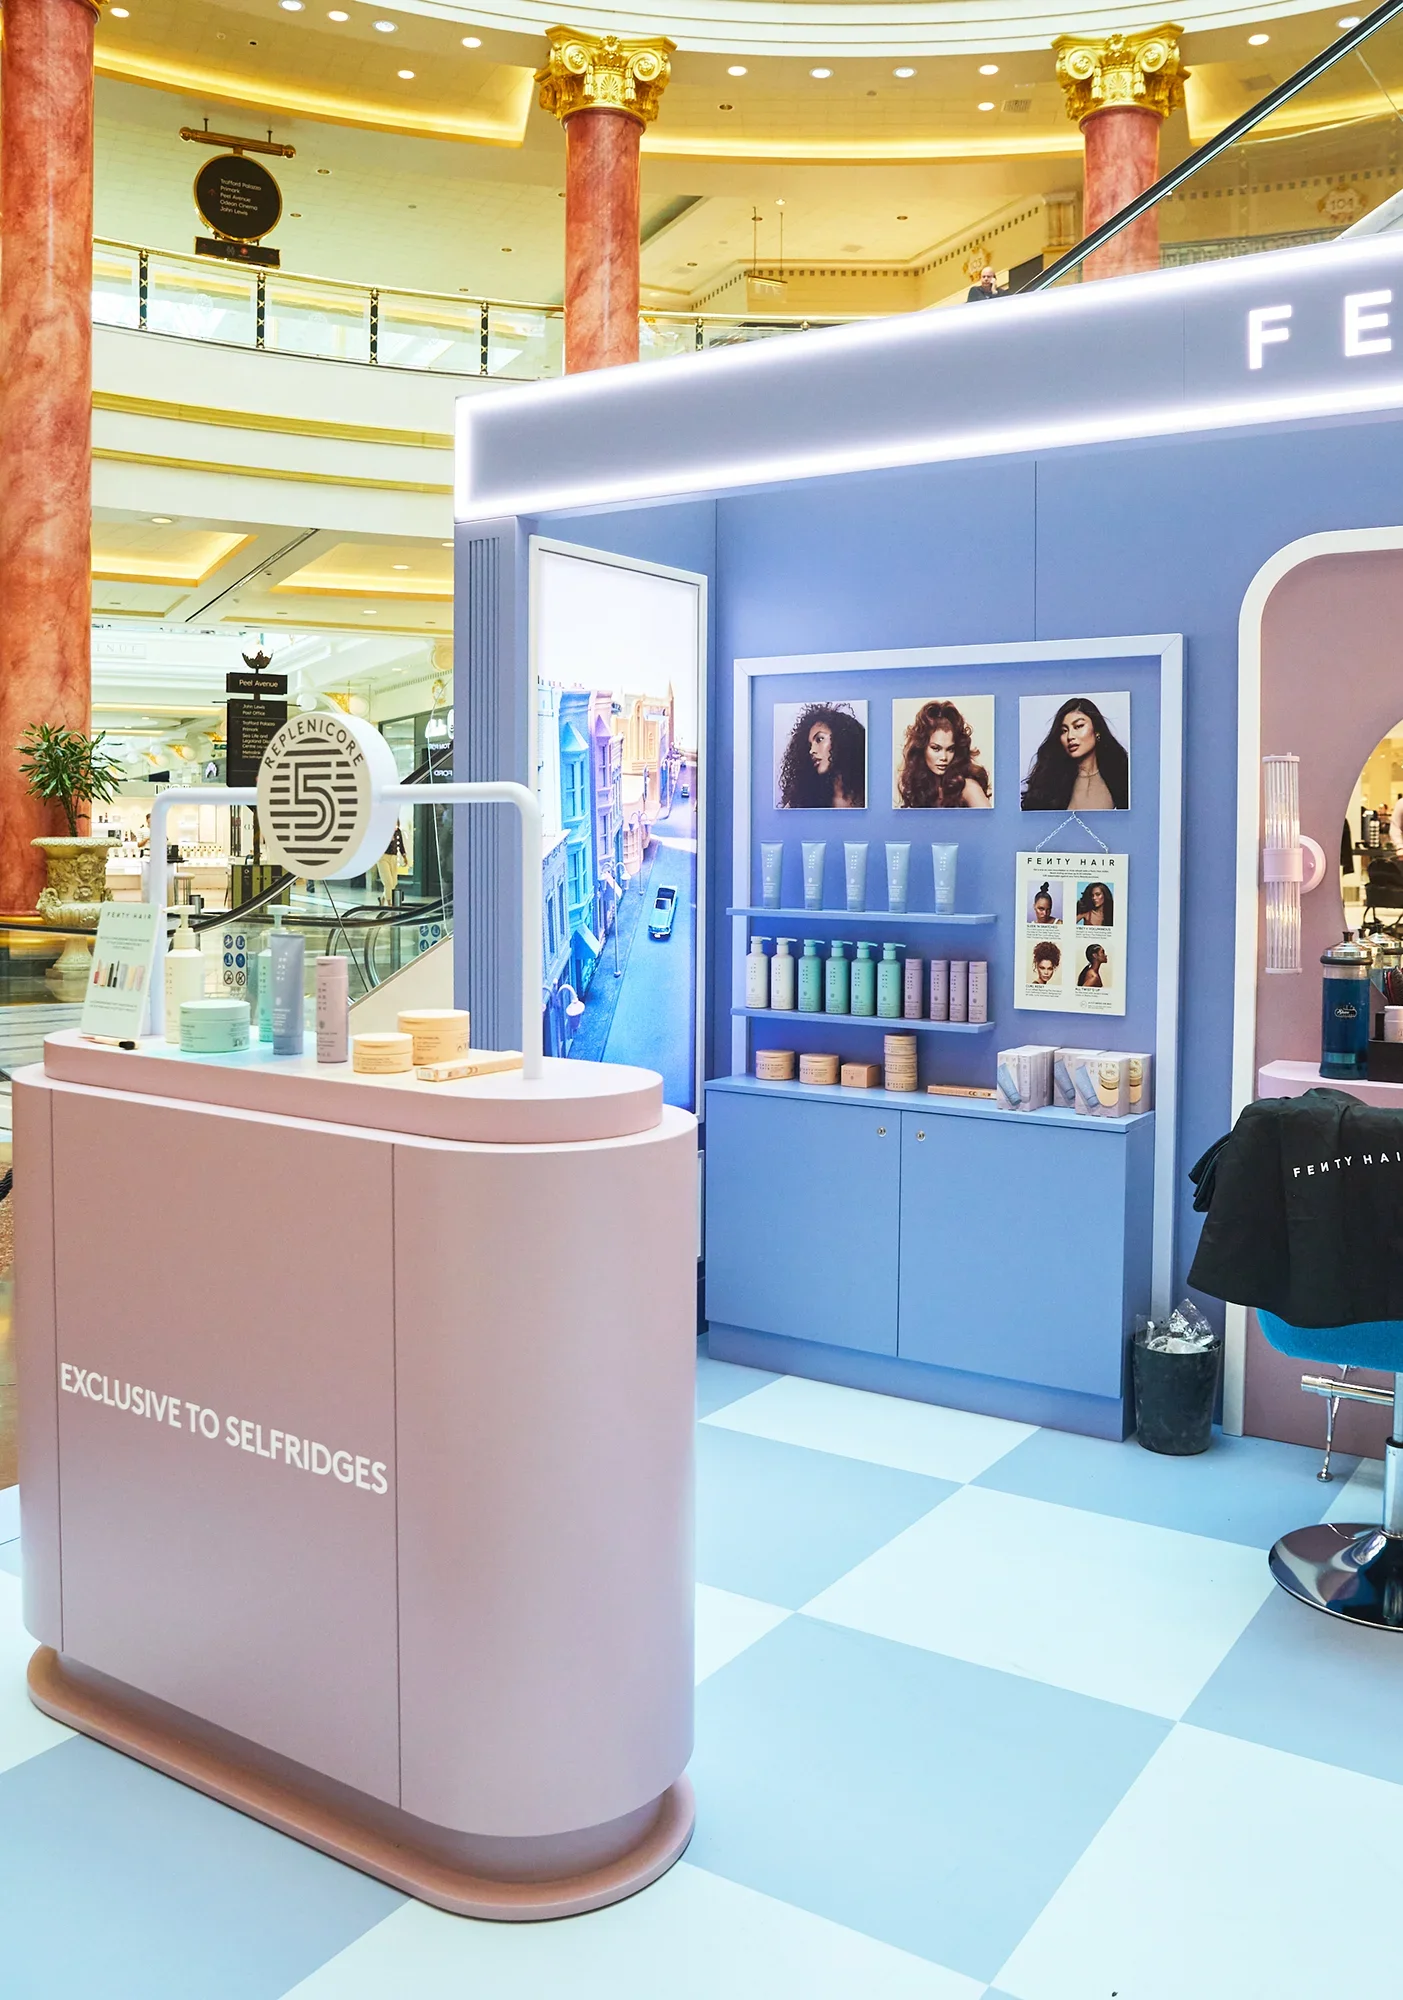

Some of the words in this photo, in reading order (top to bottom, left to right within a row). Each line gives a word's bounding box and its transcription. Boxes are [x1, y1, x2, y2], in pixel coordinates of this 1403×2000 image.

[221, 179, 241, 187] Trafford
[242, 182, 262, 191] Palazzo
[220, 199, 237, 207] Odeon
[239, 202, 258, 211] Cinema
[232, 195, 251, 203] Avenue
[234, 208, 248, 216] Lewis
[1249, 289, 1392, 370] FE
[254, 680, 279, 688] Avenue
[265, 719, 364, 769] REPLENICORE
[295, 761, 335, 842] 5
[1027, 857, 1071, 866] FENTY
[1081, 859, 1115, 867] HAIR
[1293, 1155, 1352, 1178] FENTY
[60, 1362, 182, 1429] EXCLUSIVE
[185, 1401, 220, 1439] TO
[225, 1415, 388, 1495] SELFRIDGES
